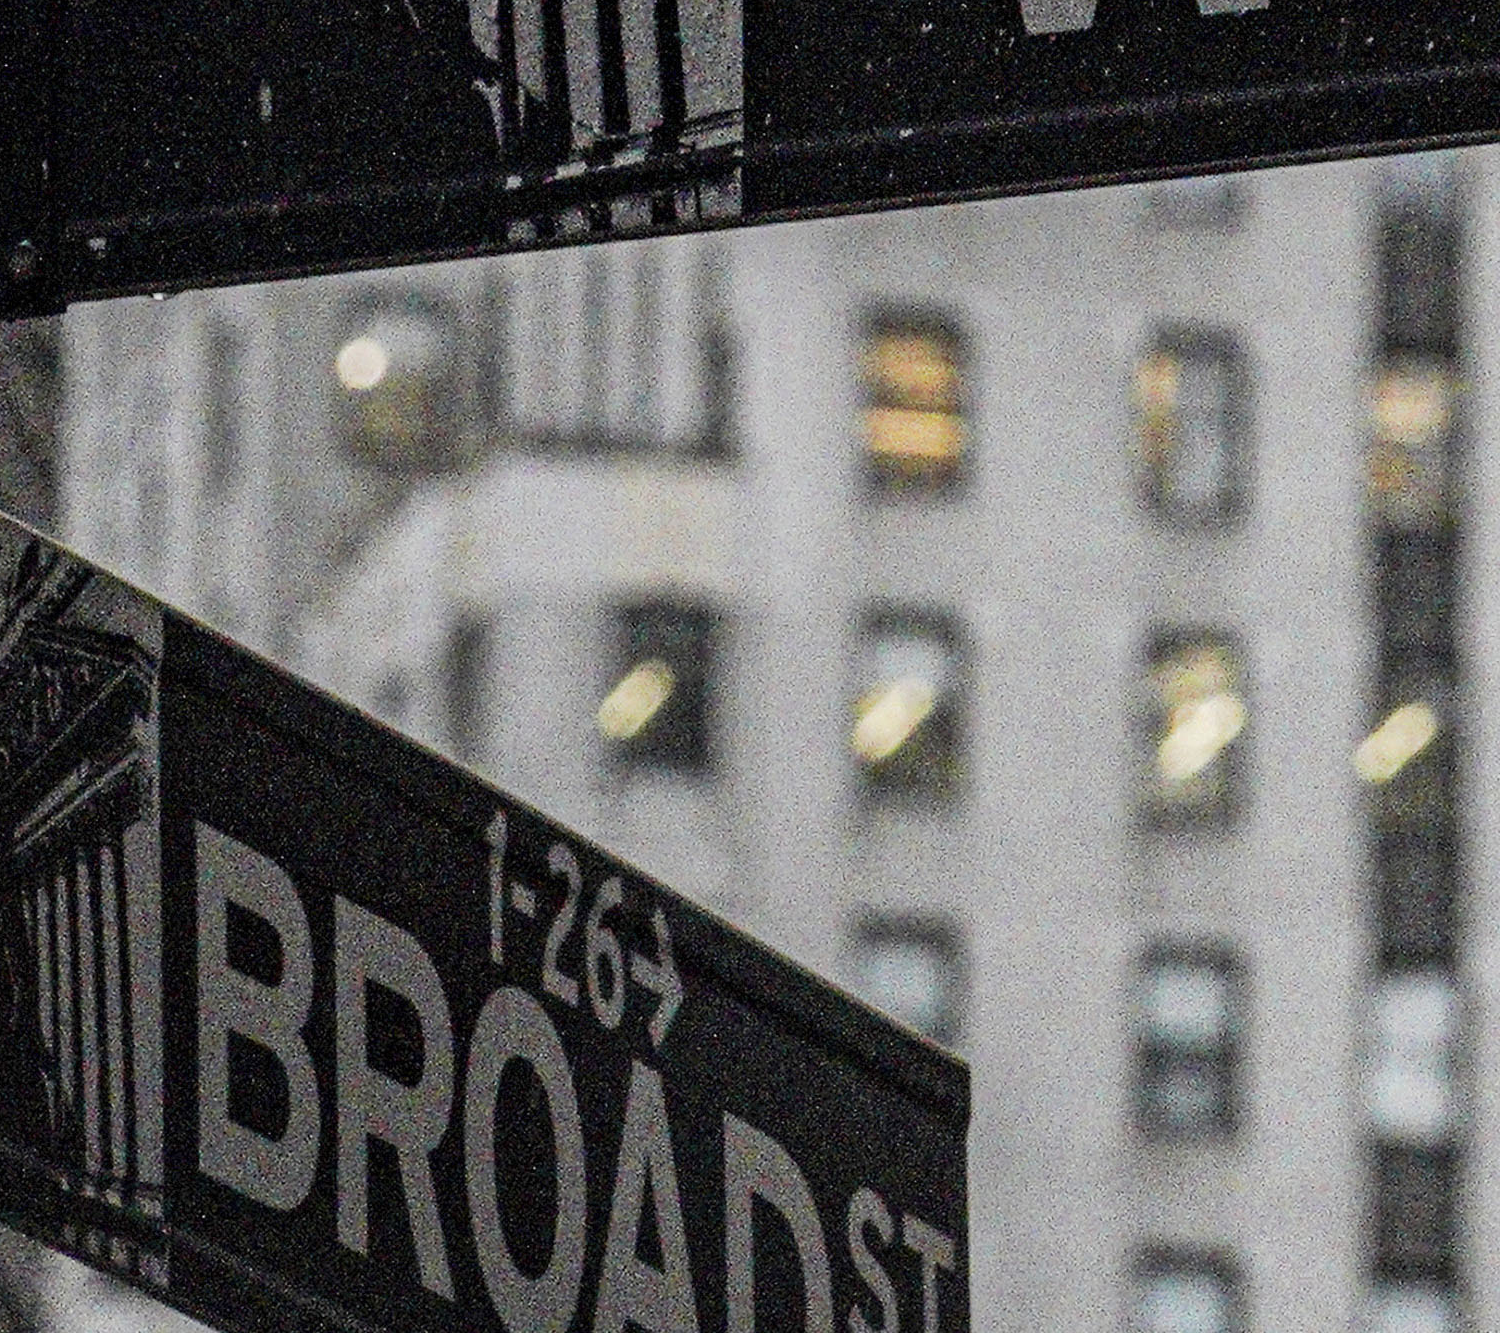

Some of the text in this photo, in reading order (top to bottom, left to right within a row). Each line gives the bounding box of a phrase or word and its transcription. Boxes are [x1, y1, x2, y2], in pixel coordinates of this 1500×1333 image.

[193, 819, 957, 1333] BROAD ST
[484, 809, 629, 1030] 1-26
